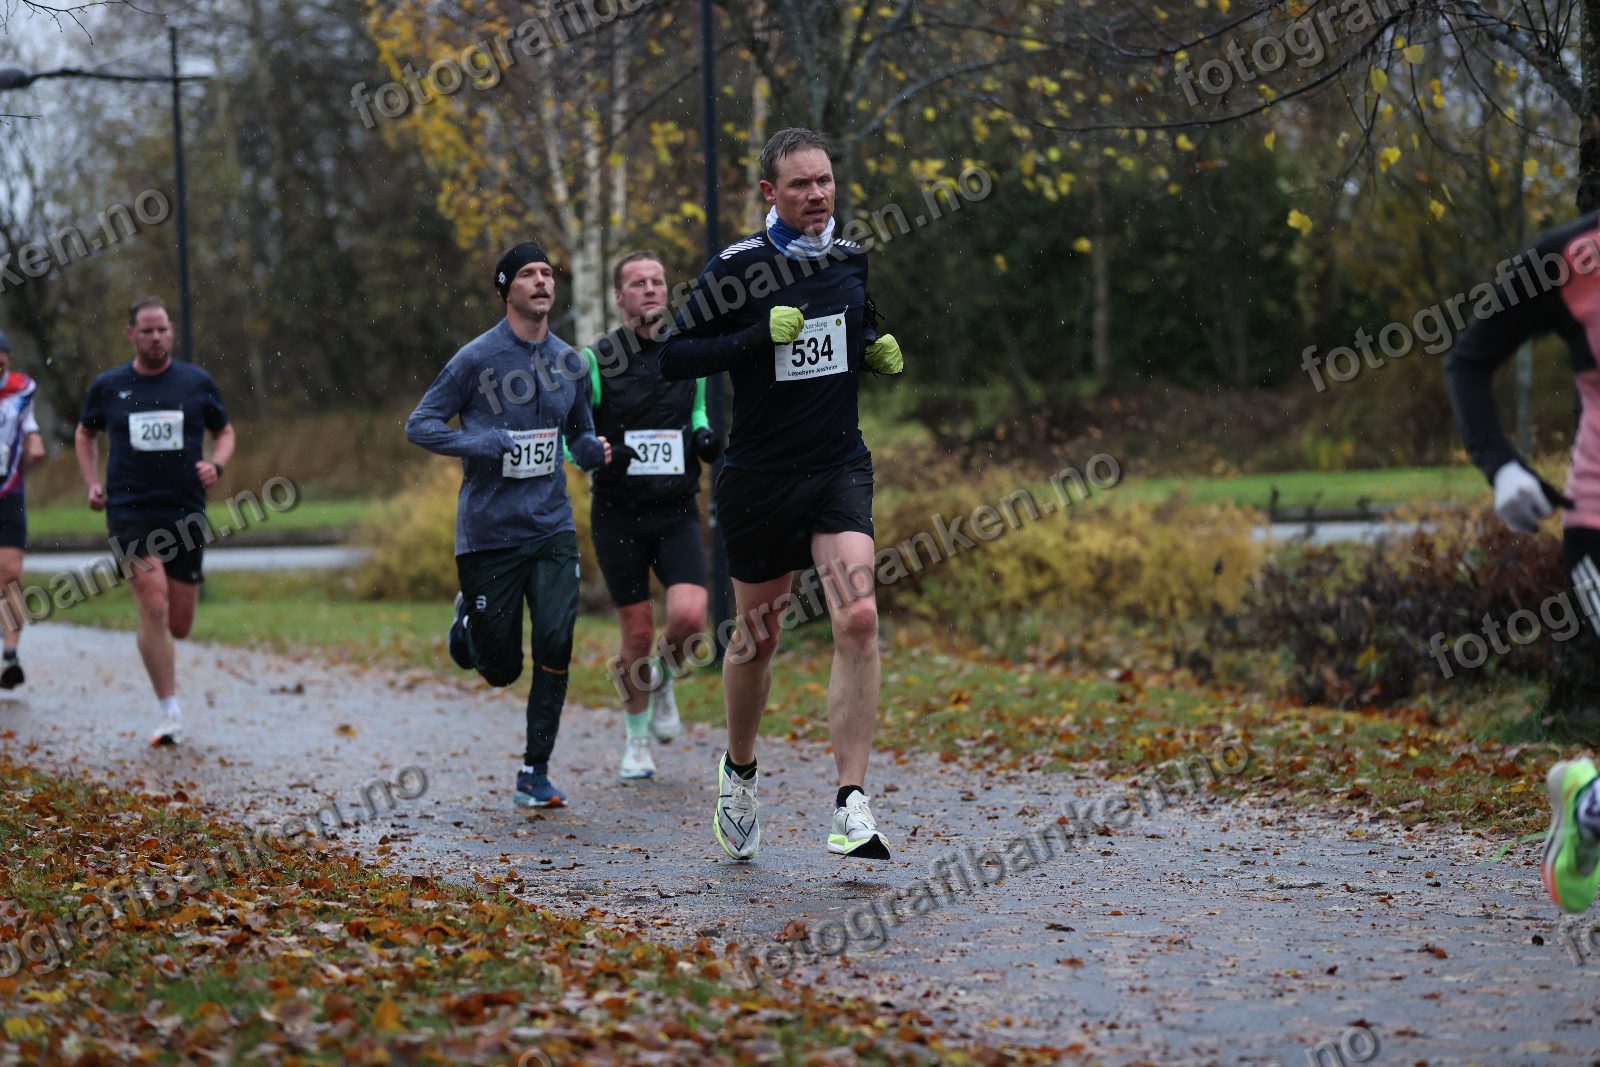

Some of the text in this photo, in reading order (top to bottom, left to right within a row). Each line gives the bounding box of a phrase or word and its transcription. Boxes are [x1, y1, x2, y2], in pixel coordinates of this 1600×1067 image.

[791, 334, 833, 367] 534
[141, 422, 172, 441] 203
[510, 441, 554, 466] 9152
[637, 442, 672, 463] 379
